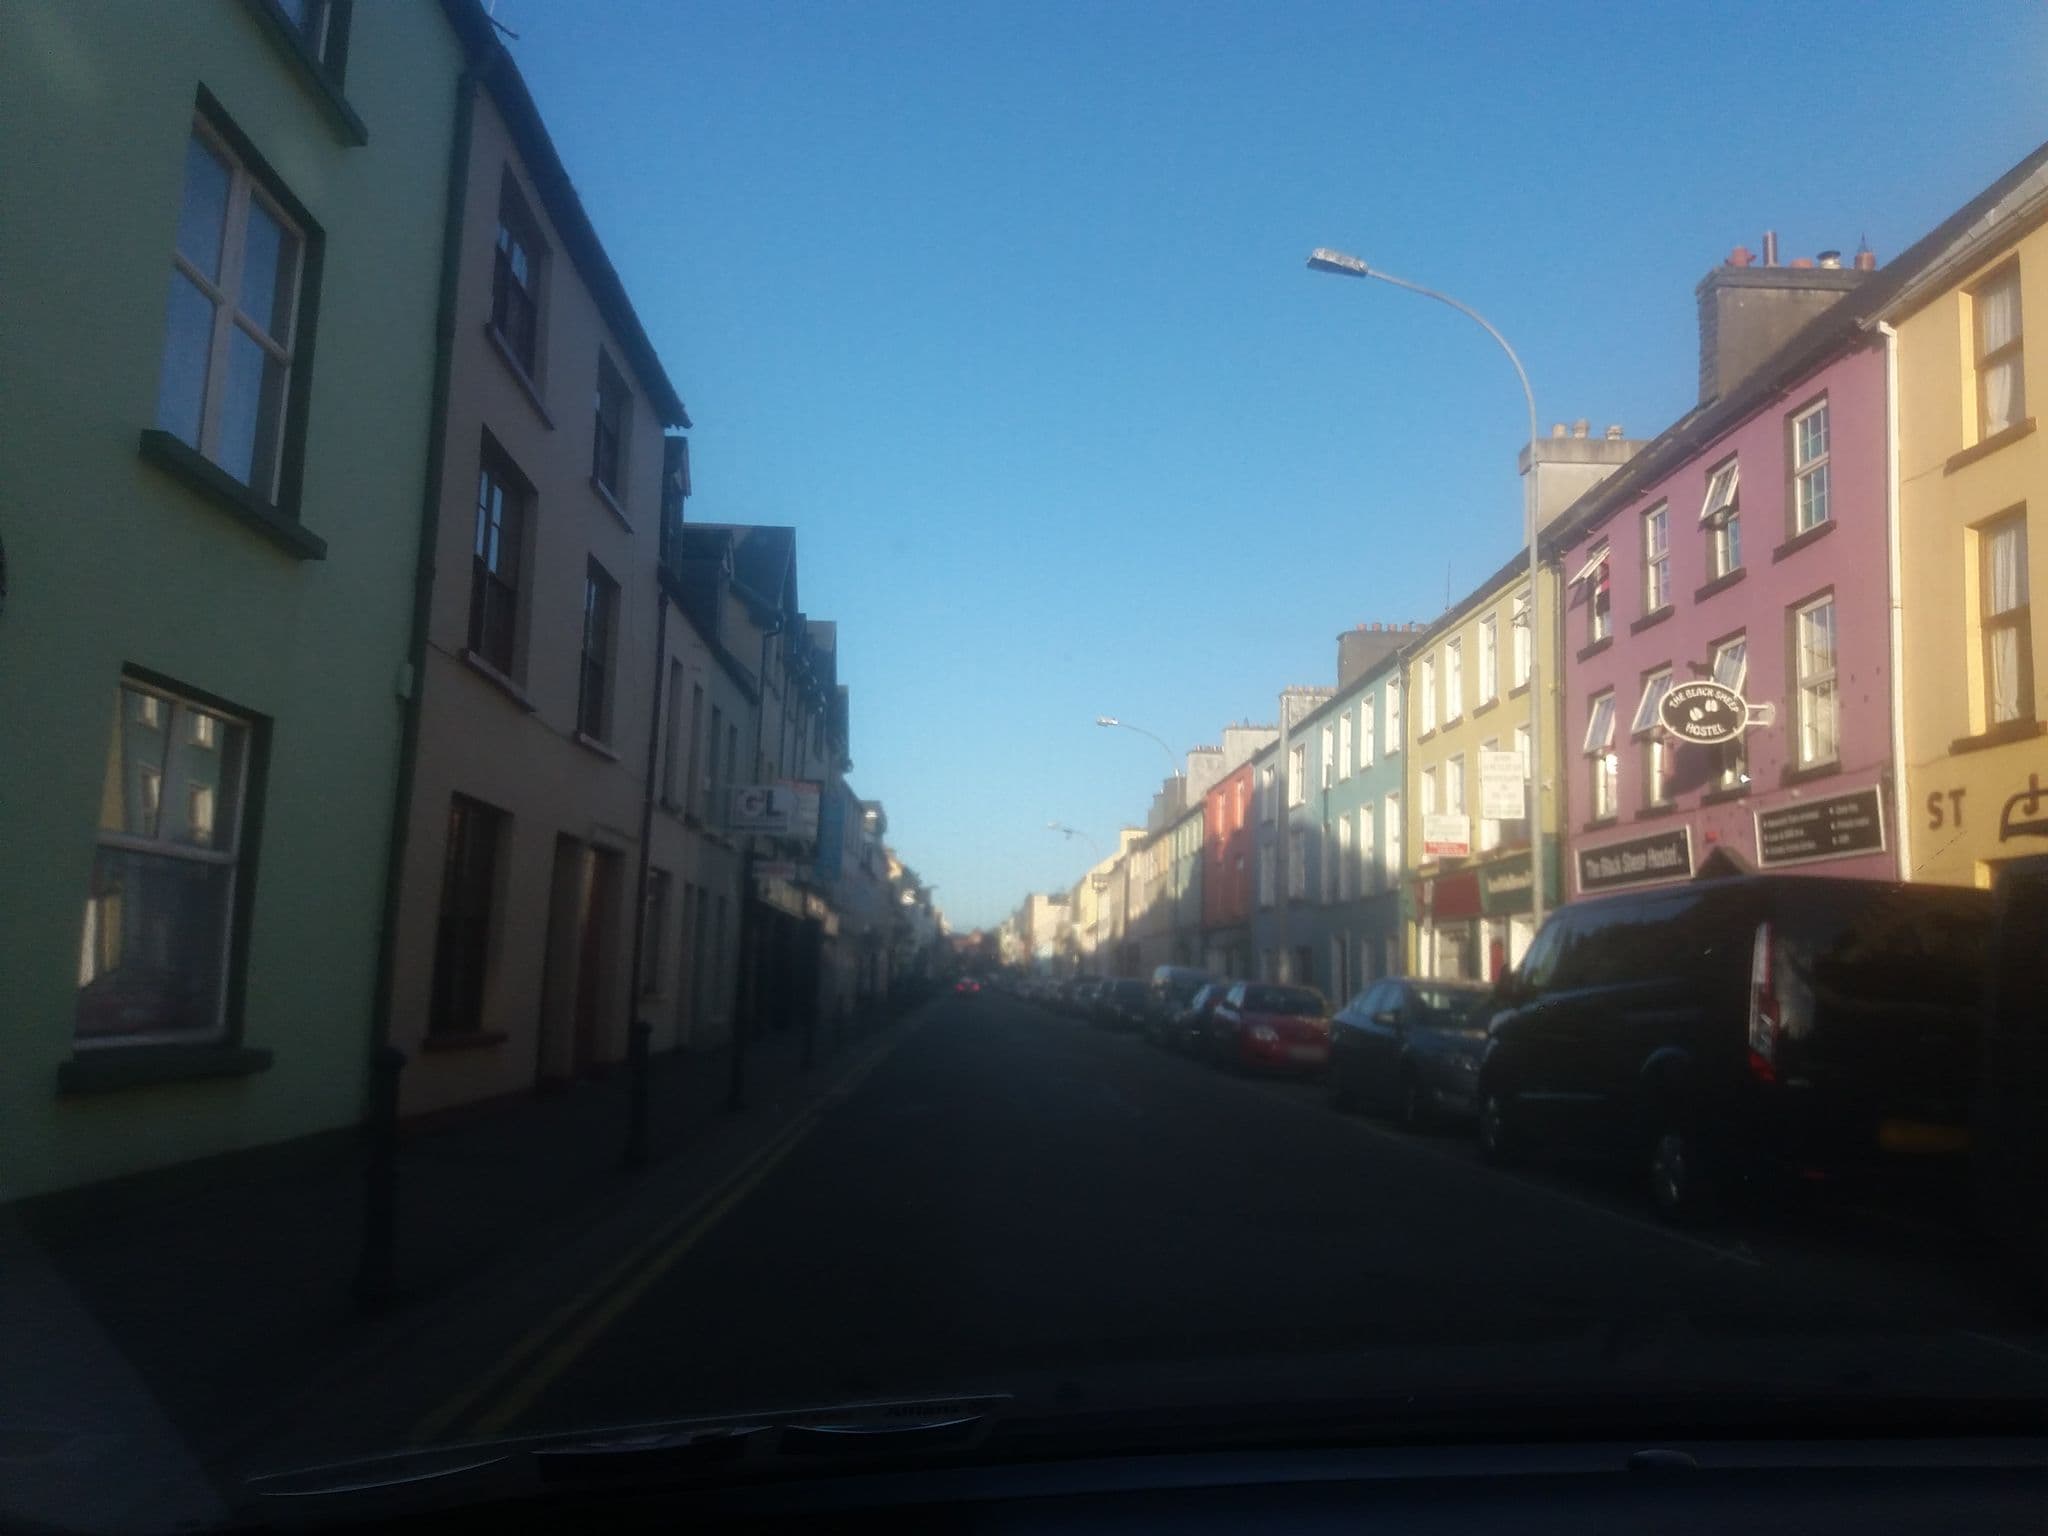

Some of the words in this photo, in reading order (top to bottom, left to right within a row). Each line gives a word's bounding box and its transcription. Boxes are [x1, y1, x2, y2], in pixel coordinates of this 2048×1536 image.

[1669, 692, 1686, 709] THE
[1685, 687, 1714, 699] BLACK
[1714, 691, 1739, 713] SHEEP
[1685, 722, 1727, 737] HOSTEL
